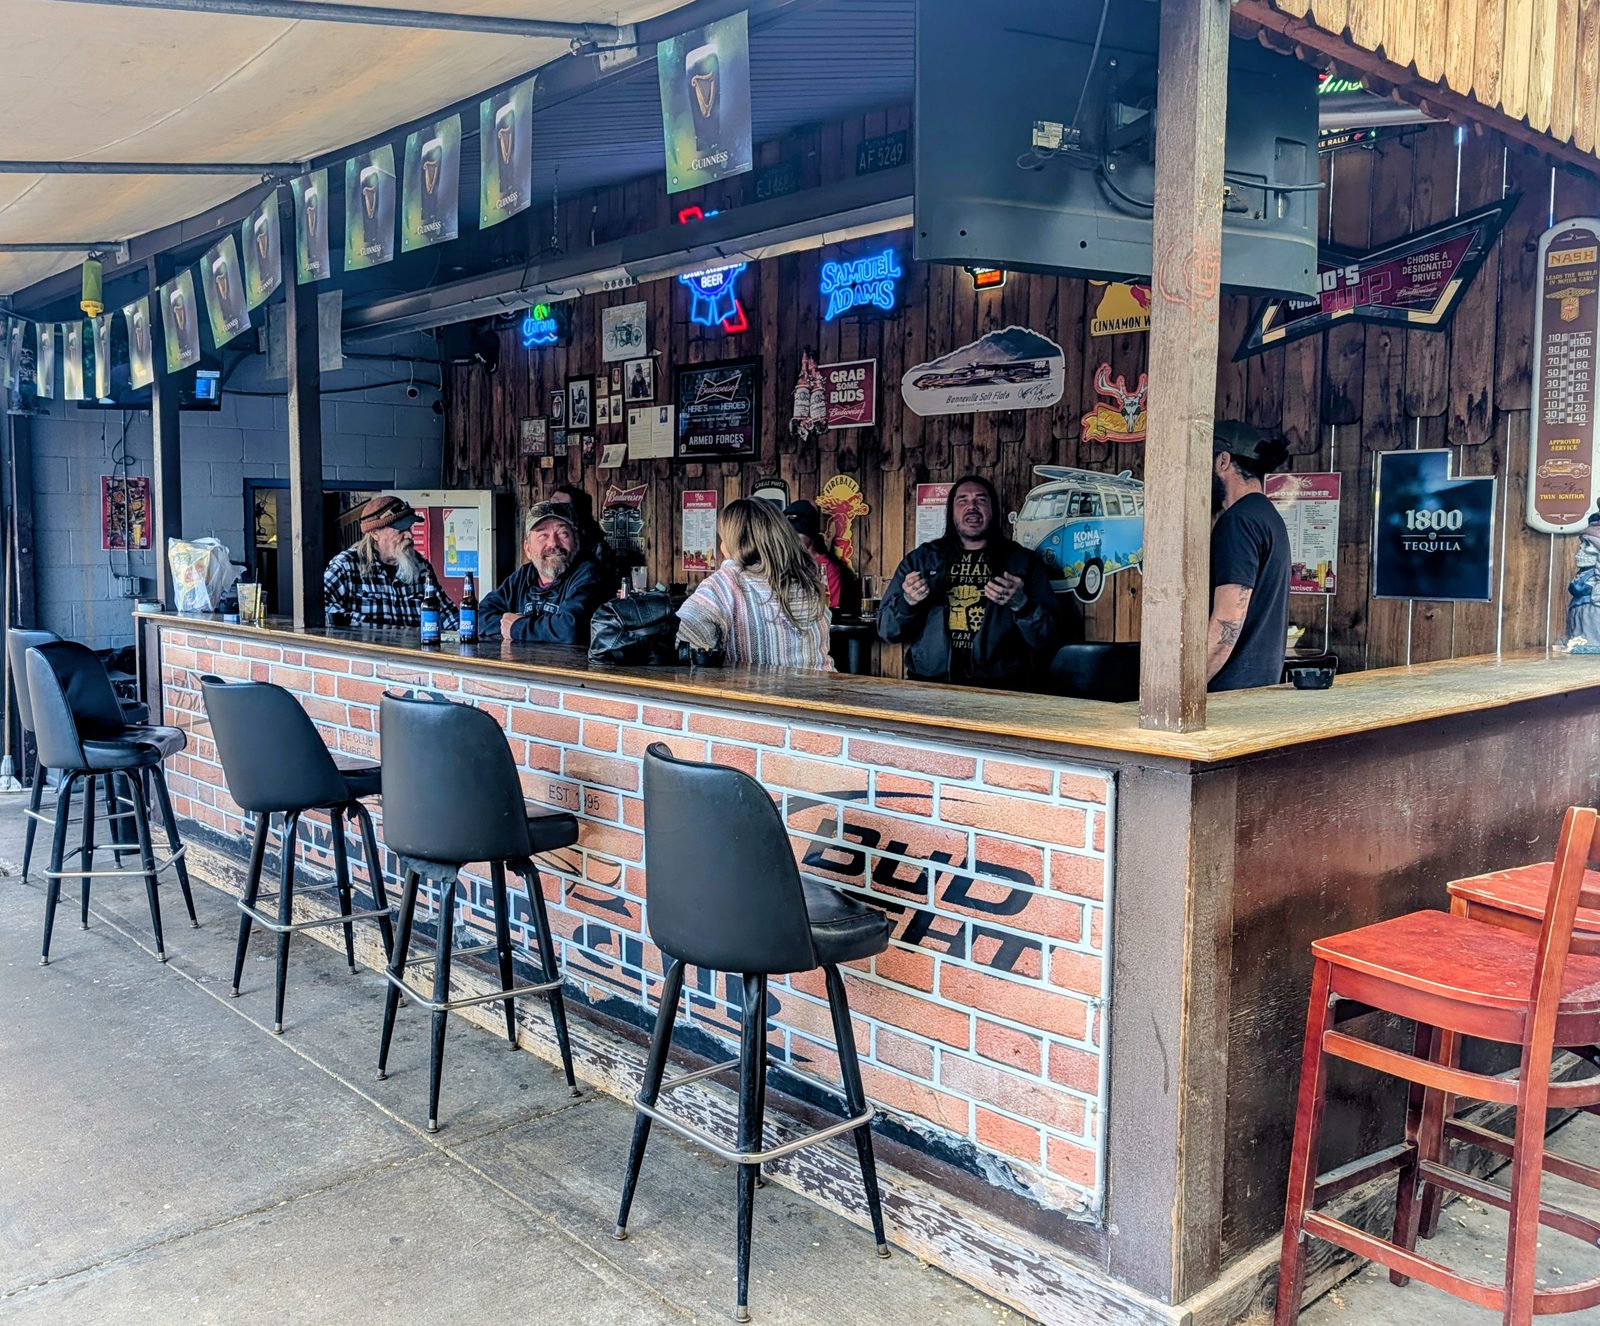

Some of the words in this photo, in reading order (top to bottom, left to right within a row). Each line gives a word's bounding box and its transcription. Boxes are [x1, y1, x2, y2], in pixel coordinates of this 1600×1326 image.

[1328, 135, 1350, 146] RALLY
[691, 150, 729, 170] GUINNESS
[859, 155, 875, 170] AF
[878, 143, 904, 168] 5249
[496, 191, 519, 209] GUINNESS
[417, 221, 442, 236] GUINNESS
[360, 243, 382, 257] GUINNESS
[1406, 254, 1440, 266] CHOOSE
[1441, 251, 1449, 261] A
[1550, 250, 1594, 266] NASH
[821, 249, 900, 293] SAMUEL
[1402, 260, 1453, 275] DESIGNATED
[1317, 264, 1361, 293] O'S
[1411, 270, 1442, 283] DRIVER
[1564, 271, 1576, 279] THE
[1577, 269, 1598, 277] WORLD
[700, 273, 723, 289] BEER
[824, 280, 895, 321] ADAMS
[523, 317, 557, 337] Corona
[1093, 316, 1141, 333] CINNAMON
[1548, 333, 1561, 341] 110
[1576, 336, 1591, 345] 100
[1548, 345, 1560, 353] 90
[1576, 348, 1589, 357] 80
[1547, 357, 1560, 365] 70
[1576, 360, 1588, 369] 60
[829, 368, 866, 383] GRAB
[1547, 368, 1559, 377] 50
[1575, 371, 1588, 380] 40
[694, 382, 739, 396] Budweiser
[836, 381, 859, 391] SOME
[1546, 379, 1559, 387] 30
[1575, 383, 1587, 391] 20
[829, 388, 865, 404] BUDS
[1547, 390, 1558, 398] 10
[687, 404, 709, 413] HERE'S
[720, 401, 746, 411] HEROES
[828, 407, 865, 418] Budweiser
[1574, 403, 1586, 412] 20
[1545, 410, 1557, 418] 30
[1574, 413, 1586, 421] 40
[688, 435, 714, 446] ARMED
[715, 433, 745, 445] FORCES
[1548, 438, 1581, 446] APPROVED
[1551, 444, 1578, 452] SERVICE
[825, 476, 859, 494] FIREBALL
[606, 489, 644, 503] Budweiser
[1539, 493, 1556, 501] TWIN
[1558, 493, 1585, 501] IGNITION
[1405, 509, 1463, 531] 1800
[1073, 529, 1100, 543] KONA
[1073, 542, 1085, 550] BIG
[1085, 539, 1100, 547] WAVE
[1402, 541, 1461, 552] TEQUILA
[959, 576, 974, 584] FIX
[1289, 584, 1313, 592] weiser
[352, 733, 374, 747] CLUB
[549, 784, 570, 802] EST
[801, 818, 1035, 916] BUD
